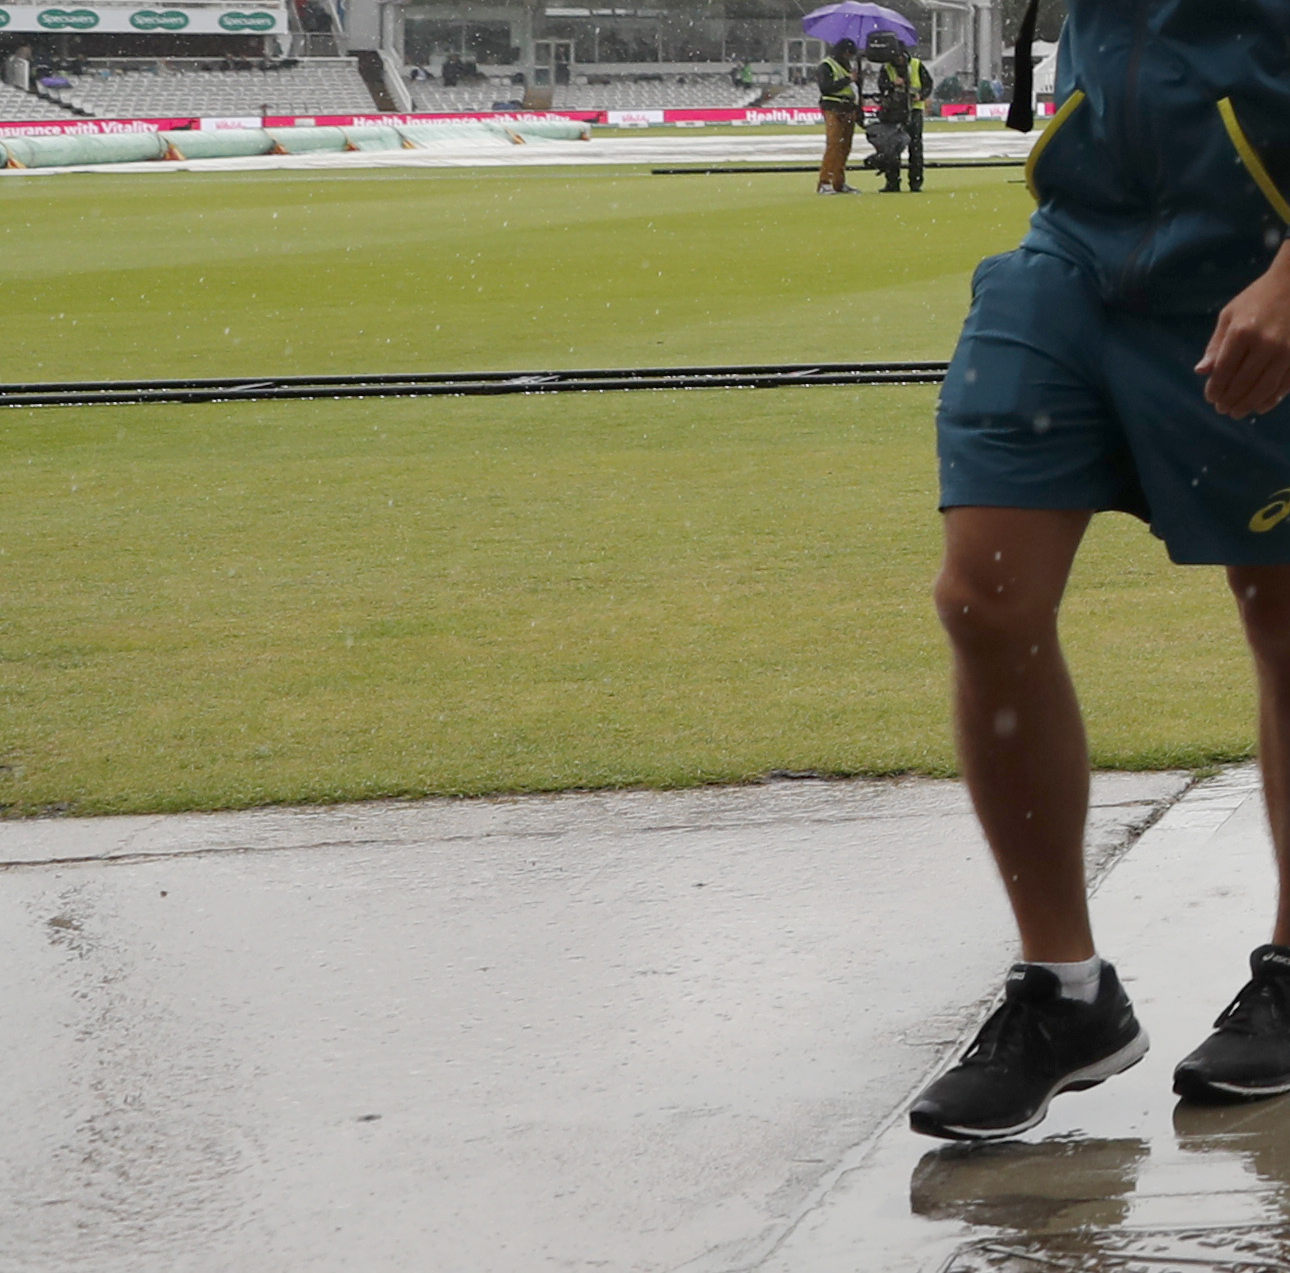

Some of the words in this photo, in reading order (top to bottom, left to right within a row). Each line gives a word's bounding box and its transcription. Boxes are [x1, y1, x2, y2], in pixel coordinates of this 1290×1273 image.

[352, 116, 403, 126] Health
[745, 109, 790, 121] Health
[0, 124, 61, 137] surance
[63, 122, 99, 135] with
[101, 120, 158, 134] Vitality
